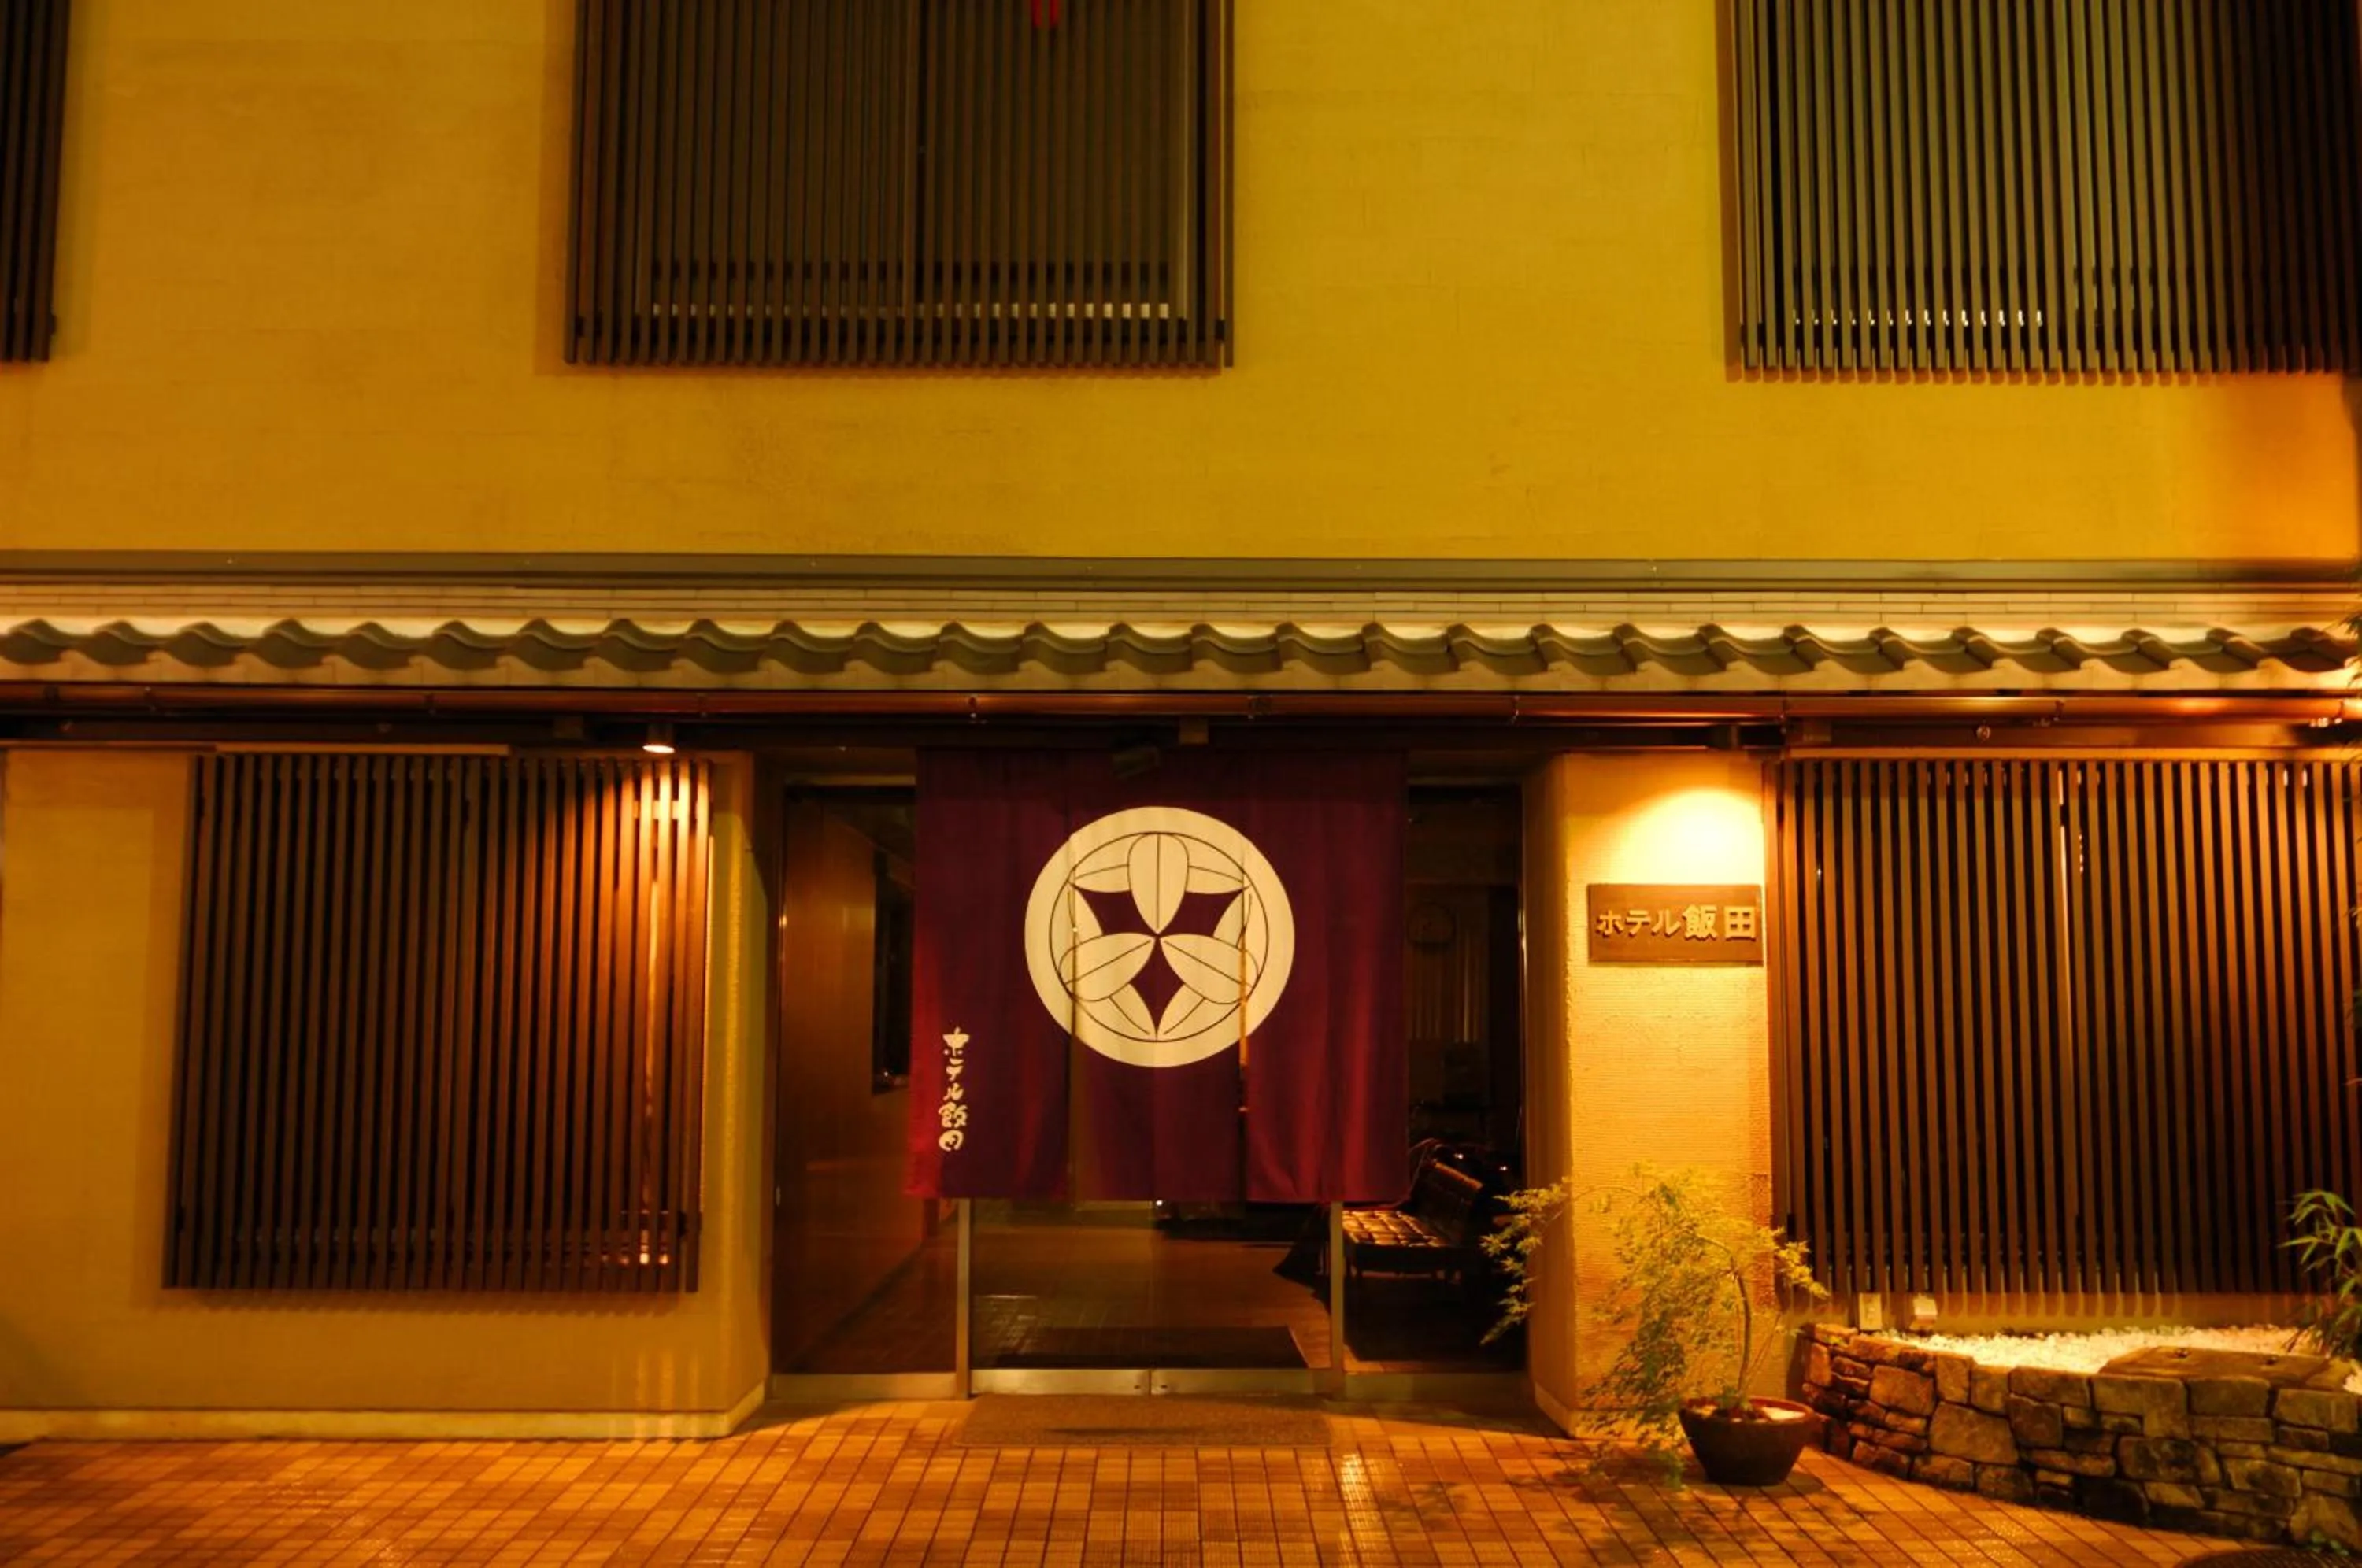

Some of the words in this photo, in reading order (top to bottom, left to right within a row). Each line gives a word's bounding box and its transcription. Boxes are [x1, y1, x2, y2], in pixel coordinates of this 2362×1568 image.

[1597, 904, 1757, 941] ホテル飯田
[938, 1026, 970, 1152] ホテル飯田
